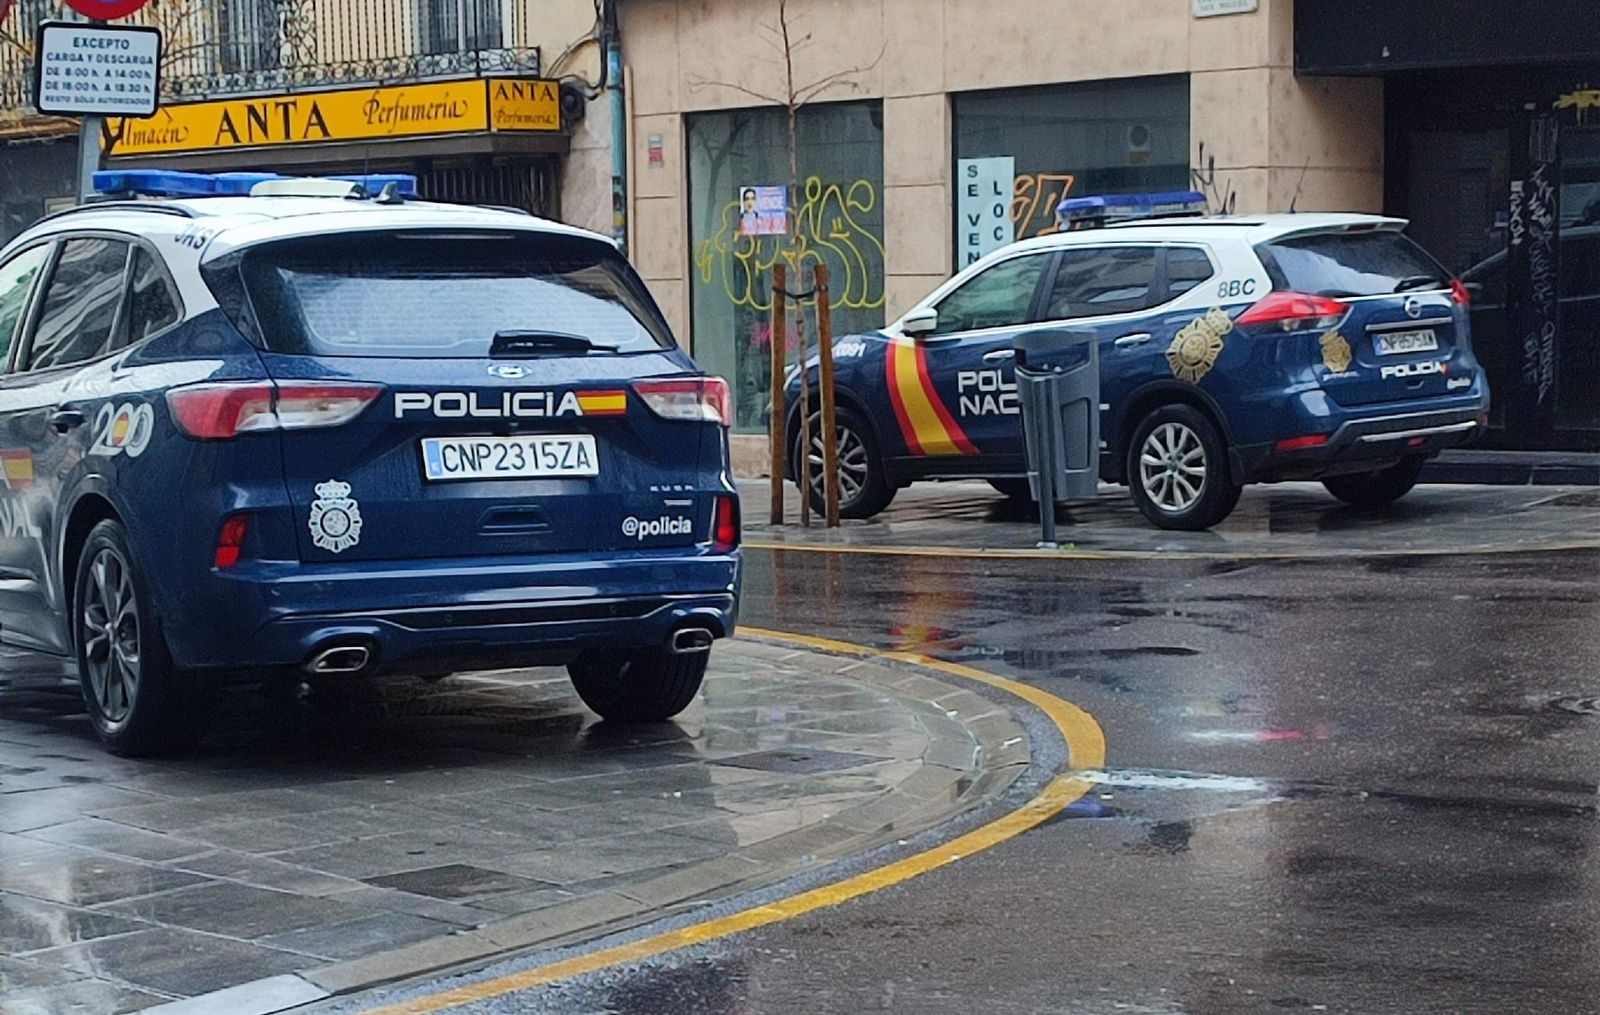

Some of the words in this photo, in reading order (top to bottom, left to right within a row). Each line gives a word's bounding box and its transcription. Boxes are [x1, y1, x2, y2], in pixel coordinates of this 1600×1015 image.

[73, 37, 130, 49] EXCEPTO
[46, 52, 84, 62] CARGA
[87, 53, 93, 62] Y
[96, 54, 153, 65] DESCARGA
[45, 67, 60, 76] DE
[104, 69, 111, 78] A
[45, 81, 59, 90] DE
[104, 83, 111, 91] A
[494, 82, 556, 101] ANTA
[214, 99, 332, 145] ANTA
[1217, 278, 1256, 298] 8BC
[957, 368, 1017, 394] POL
[959, 392, 1020, 416] NAC
[88, 401, 154, 457] 200
[442, 441, 591, 473] CNP2315ZA
[621, 516, 693, 541] @policia
